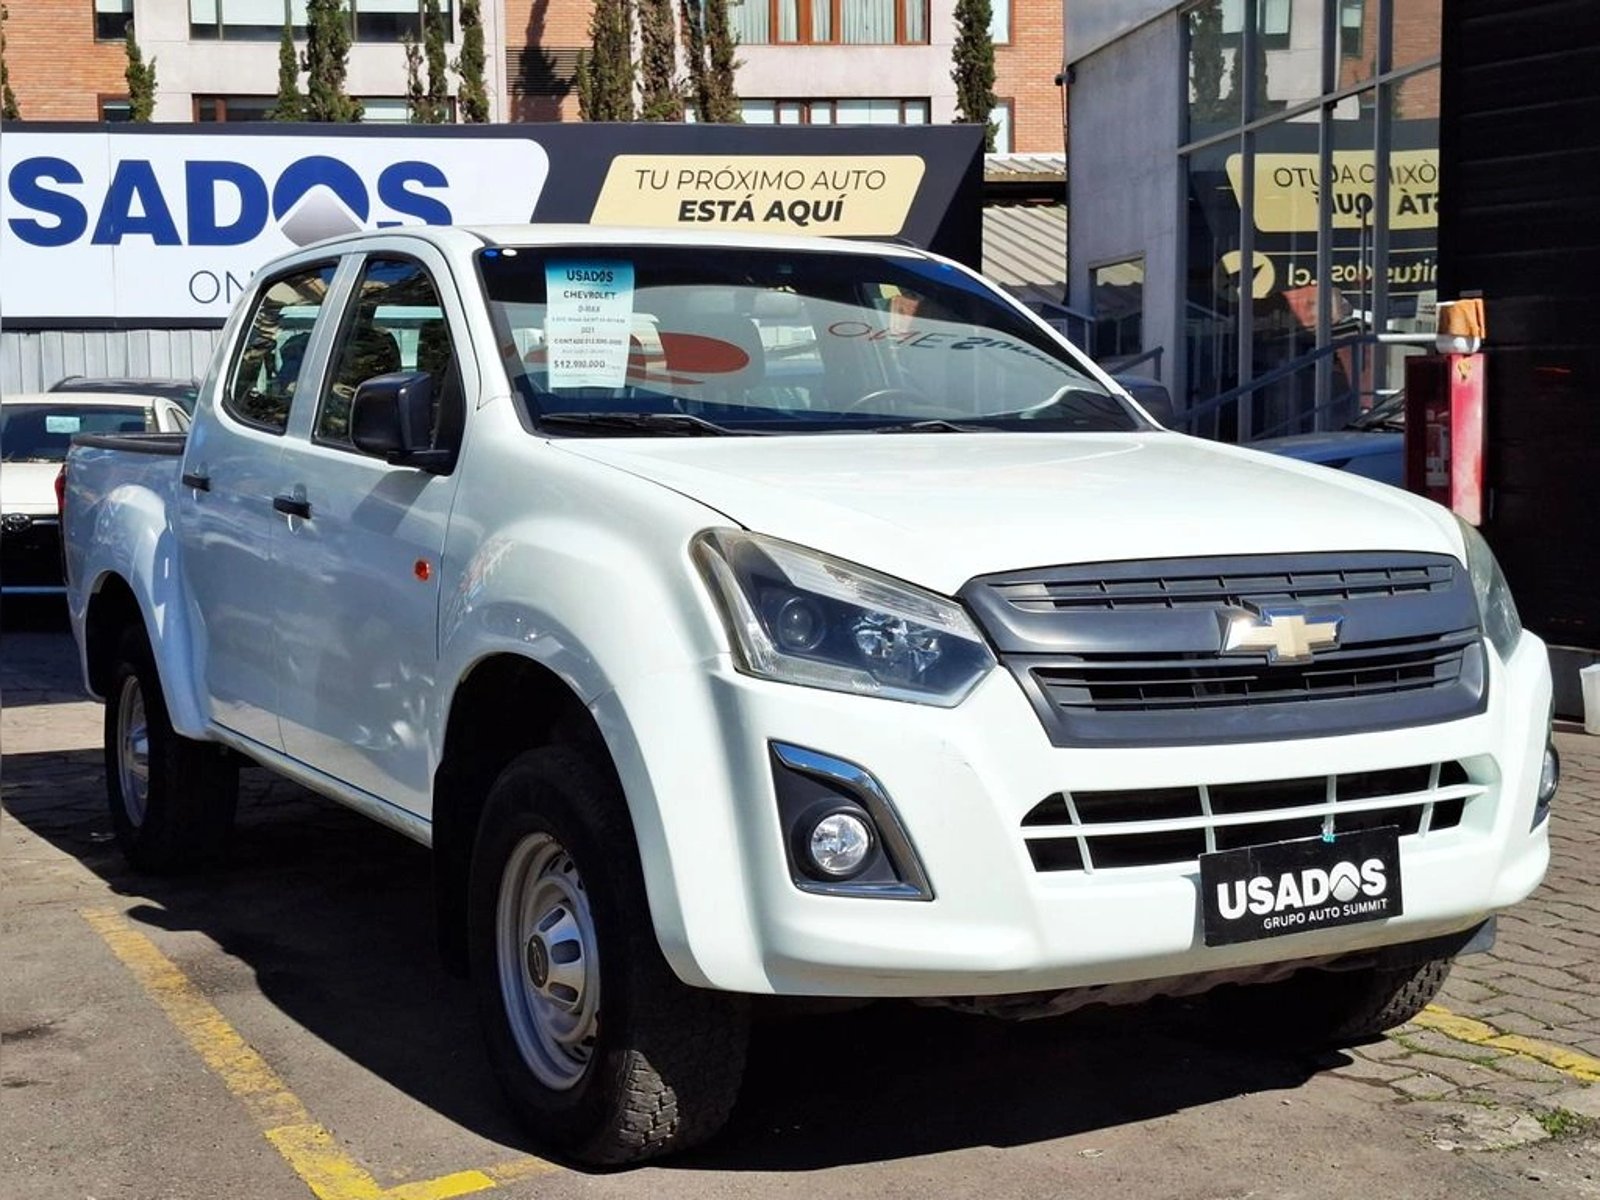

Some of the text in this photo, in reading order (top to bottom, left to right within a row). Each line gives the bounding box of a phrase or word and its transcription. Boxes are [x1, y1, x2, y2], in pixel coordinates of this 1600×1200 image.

[635, 165, 886, 191] TU PRÓXIMO AUTO
[677, 193, 848, 227] ESTÁ AQUÍ
[566, 270, 614, 283] USADOS
[563, 290, 616, 300] CHEVROLET
[1216, 858, 1387, 920] USADOS
[1263, 898, 1388, 929] GRUPO AUTO SUMMIT
